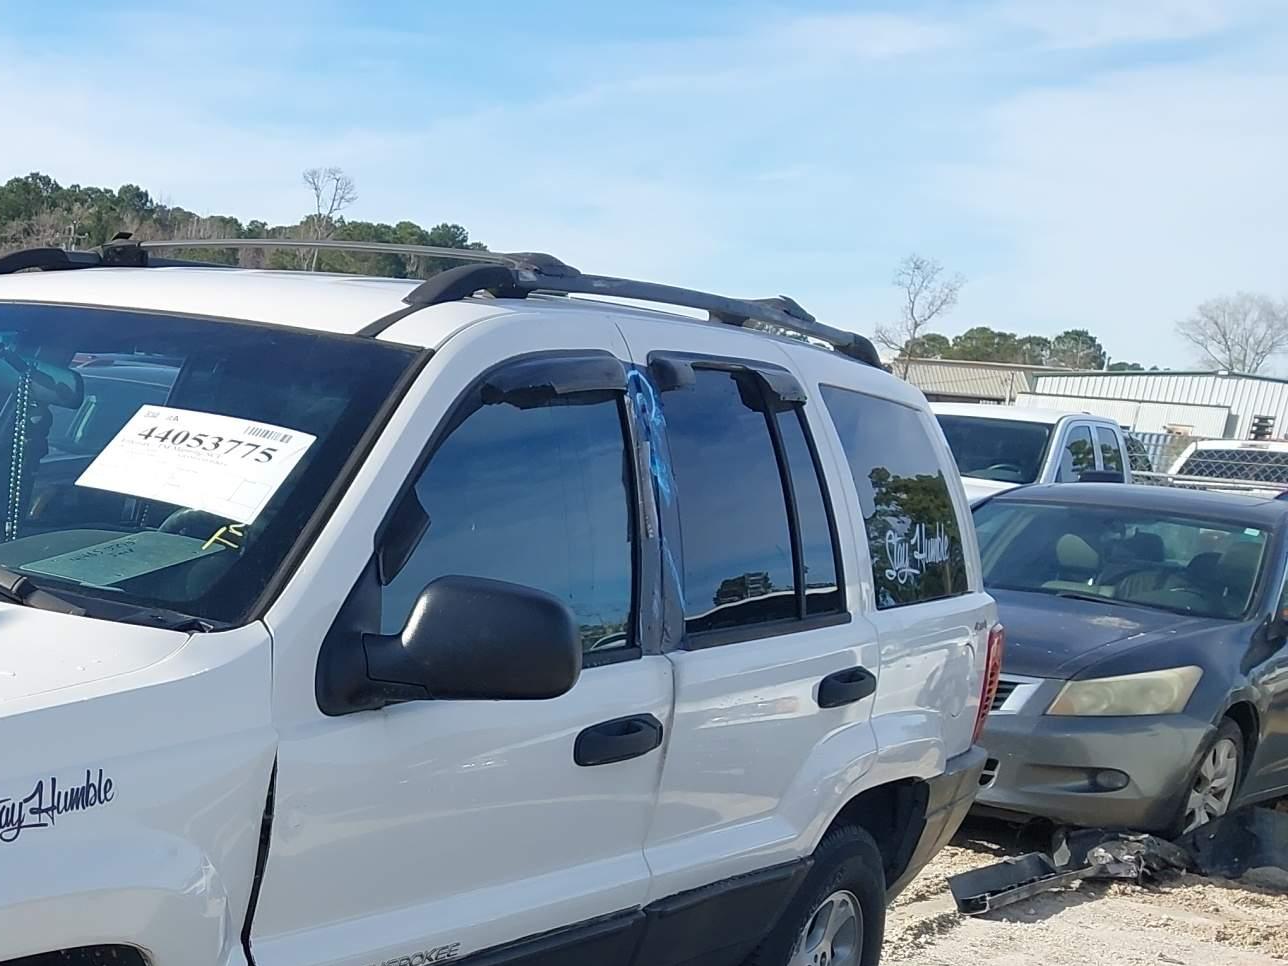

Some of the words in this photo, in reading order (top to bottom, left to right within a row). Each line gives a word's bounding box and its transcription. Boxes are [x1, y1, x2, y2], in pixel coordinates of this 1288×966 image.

[137, 426, 279, 464] 44053775
[885, 530, 921, 584] Stay
[911, 521, 951, 572] Humble
[23, 768, 114, 826] Humble
